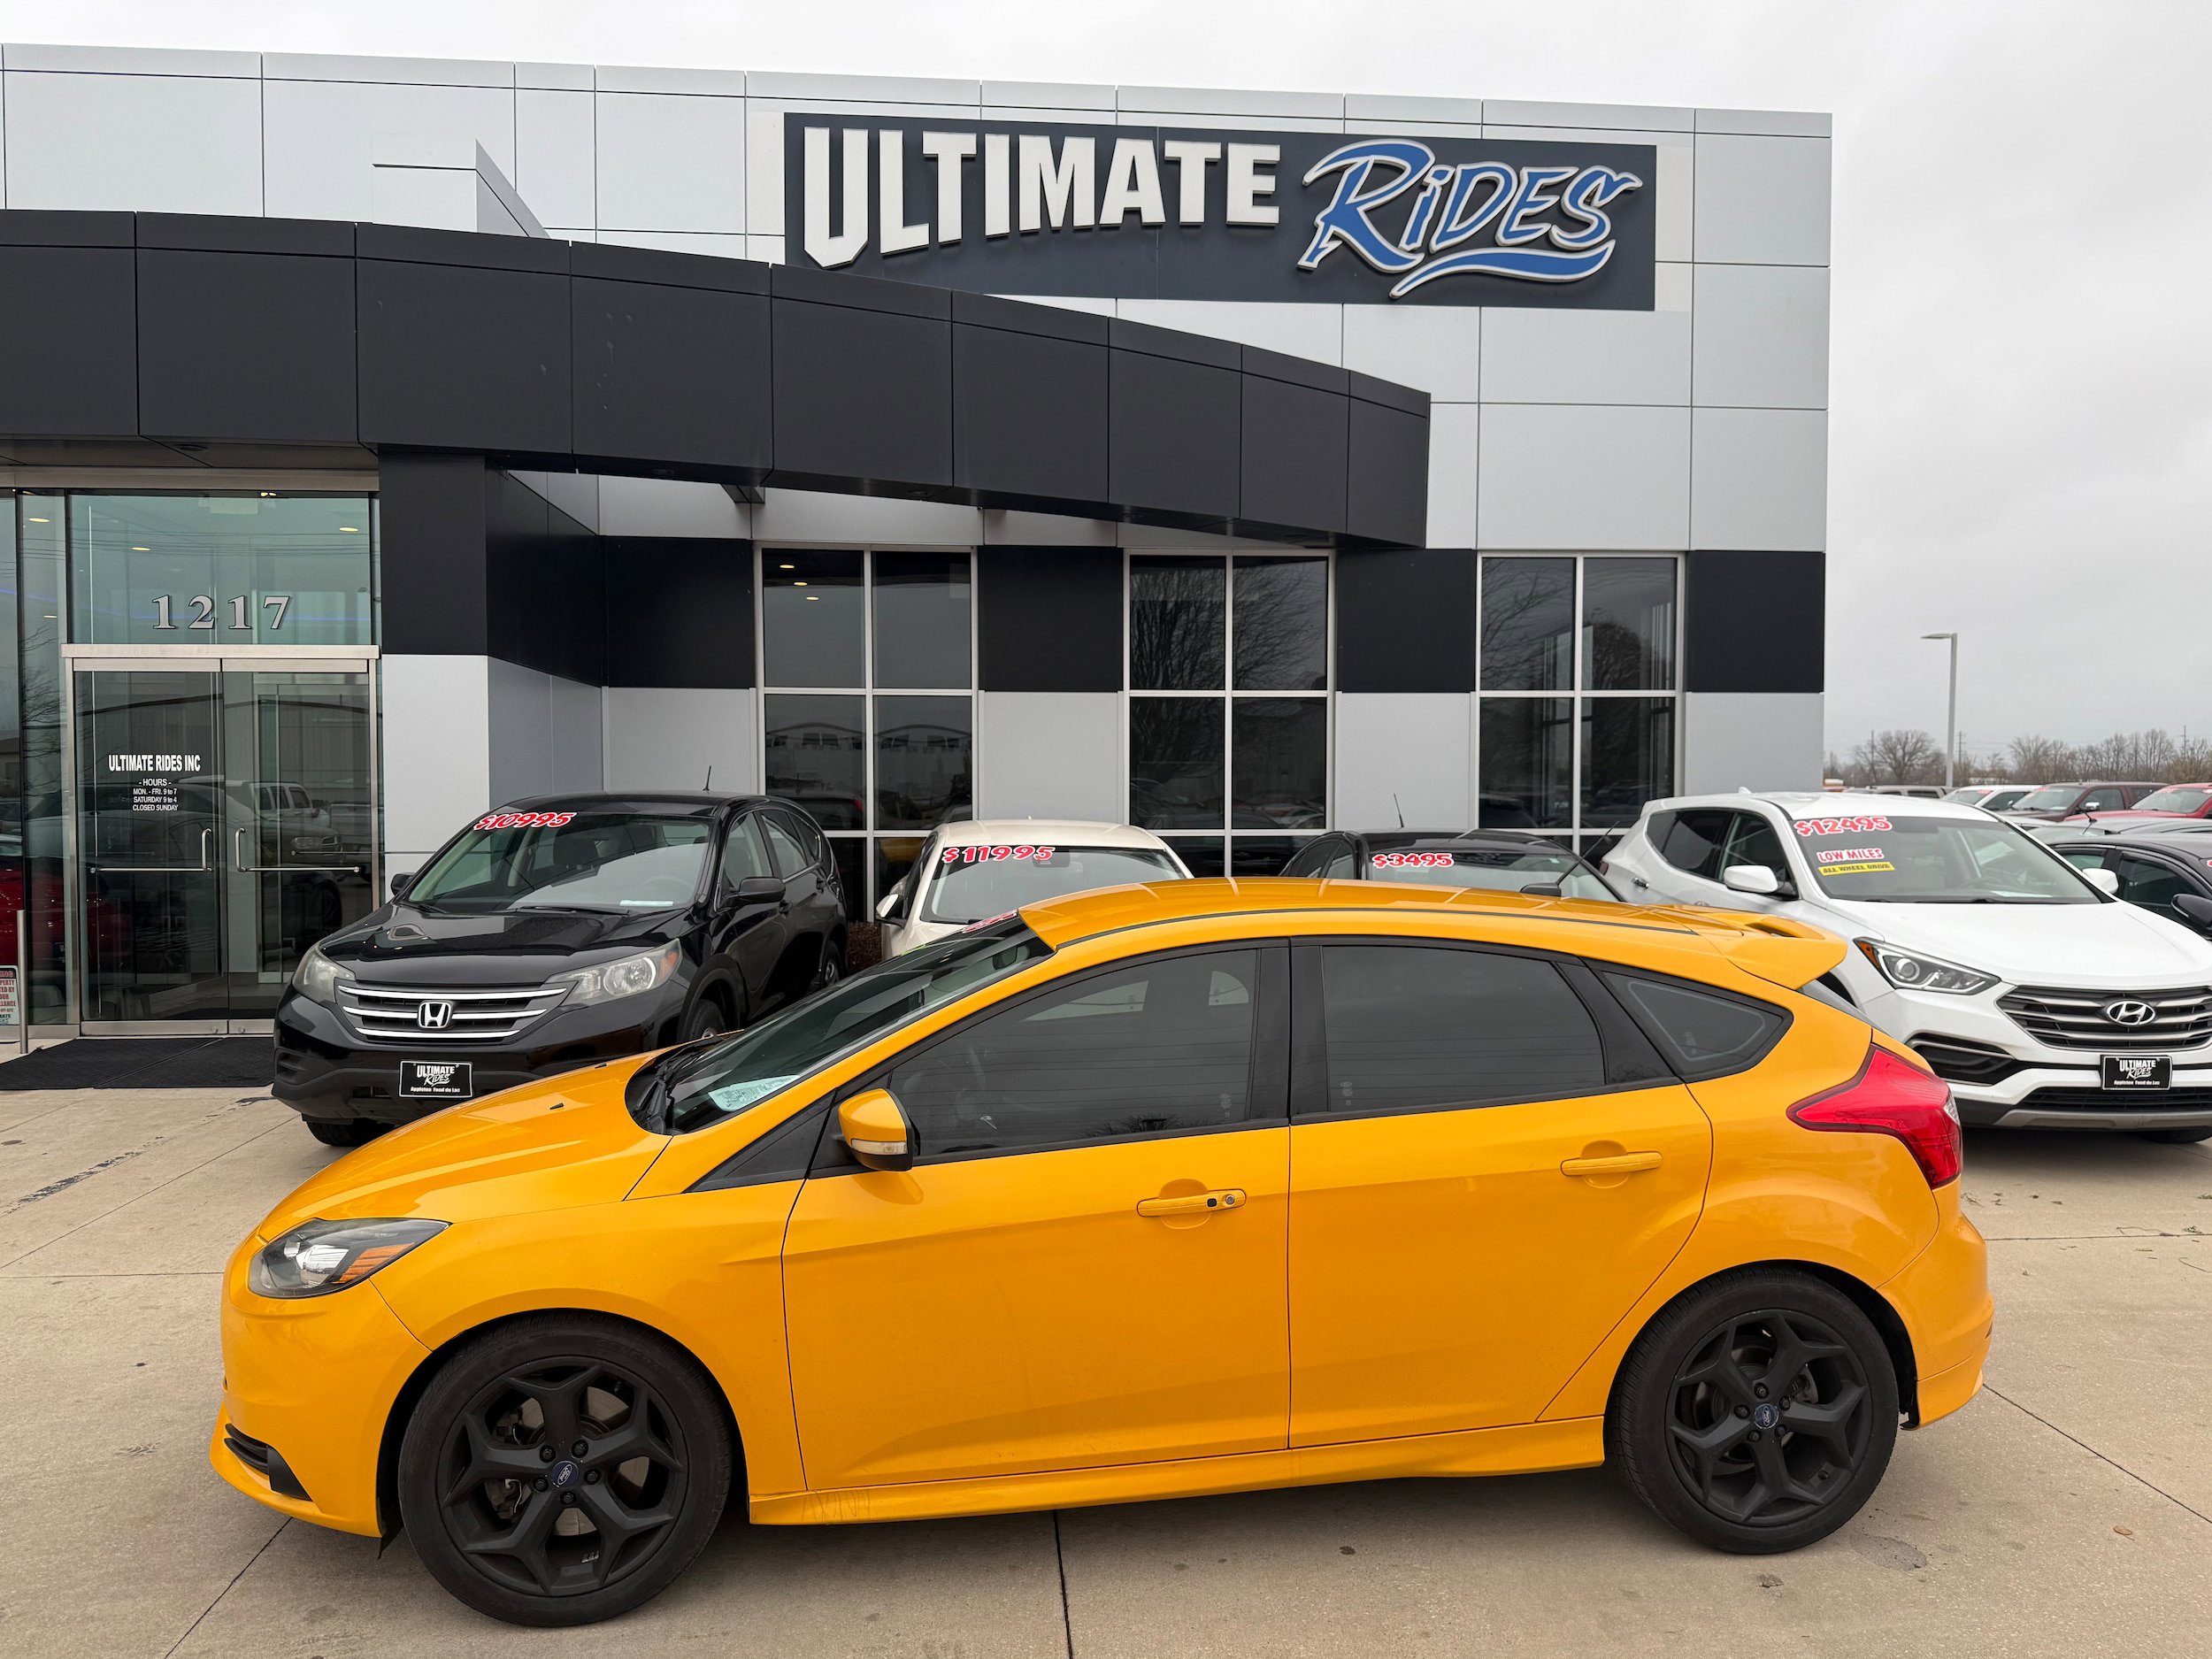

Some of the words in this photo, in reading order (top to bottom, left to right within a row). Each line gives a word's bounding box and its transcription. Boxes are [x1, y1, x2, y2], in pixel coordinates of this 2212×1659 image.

[803, 127, 1281, 268] ULTIMATE
[151, 594, 291, 630] 1217
[108, 754, 154, 772] ULTIMATE
[155, 754, 182, 772] RIDES
[184, 754, 201, 772] INC
[142, 778, 168, 787] HOURS
[472, 812, 578, 830] $10995
[1793, 816, 1893, 836] $12495
[941, 845, 1056, 864] $11995
[1372, 853, 1455, 869] $3495
[1816, 850, 1844, 864] LOW
[1846, 848, 1885, 861] MILES
[416, 1064, 456, 1078] ULTIMATE
[2118, 1059, 2156, 1072] ULTIMATE
